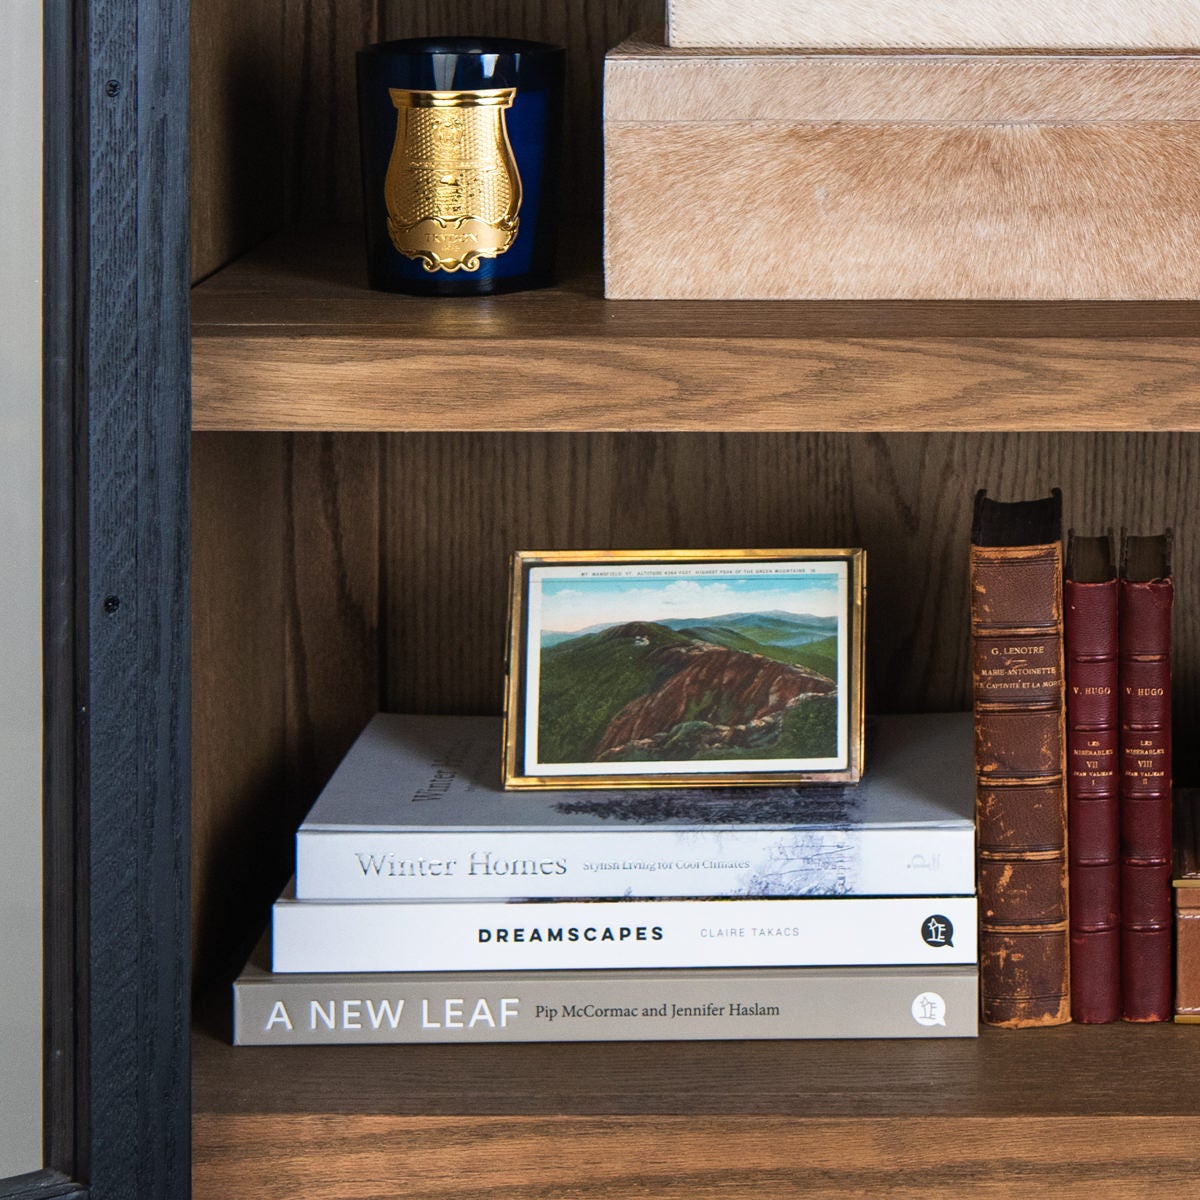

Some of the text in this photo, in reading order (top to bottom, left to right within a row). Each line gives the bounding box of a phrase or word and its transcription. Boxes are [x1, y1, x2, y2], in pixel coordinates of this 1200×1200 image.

[991, 646, 1045, 656] G. LENOTRE
[981, 667, 1057, 676] MARIE-ANTOINETTE
[1073, 687, 1111, 695] V. HUGO
[1137, 688, 1164, 696] HUGO
[1137, 760, 1153, 768] VIII
[354, 851, 457, 877] Winter
[468, 851, 568, 876] Homes
[477, 926, 800, 943] DREAMSCAPES CLAIRE TAKACS
[265, 997, 780, 1031] A NEW LEAF Pip McCormac and Jennifer Haslam
